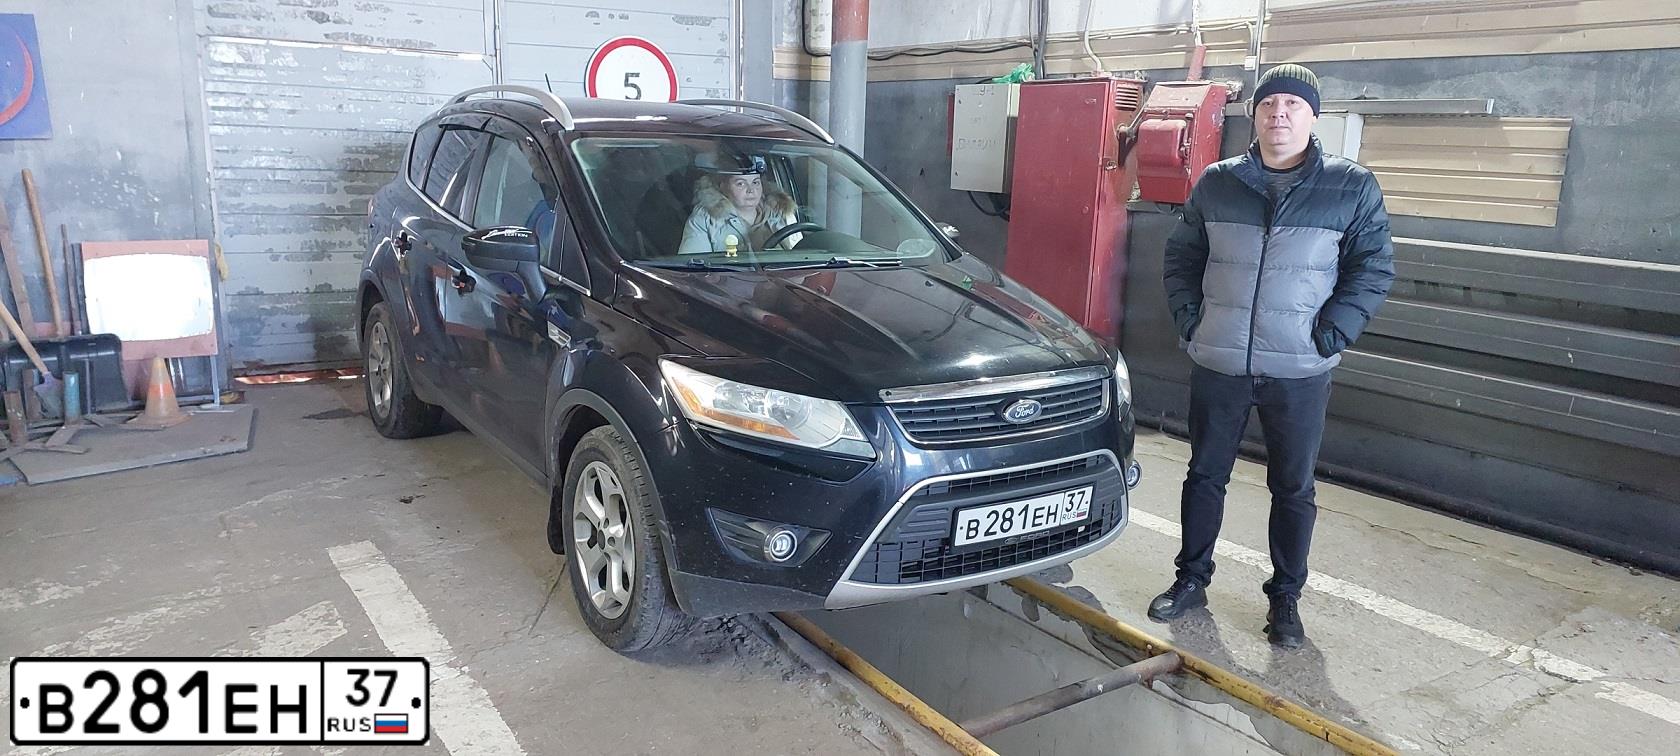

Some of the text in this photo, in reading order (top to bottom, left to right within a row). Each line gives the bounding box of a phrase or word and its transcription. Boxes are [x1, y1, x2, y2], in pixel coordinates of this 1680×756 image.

[624, 72, 642, 101] 5
[1014, 404, 1035, 418] Ford
[1064, 490, 1087, 513] 37
[1062, 511, 1077, 520] RUS
[1020, 530, 1050, 542] FORD
